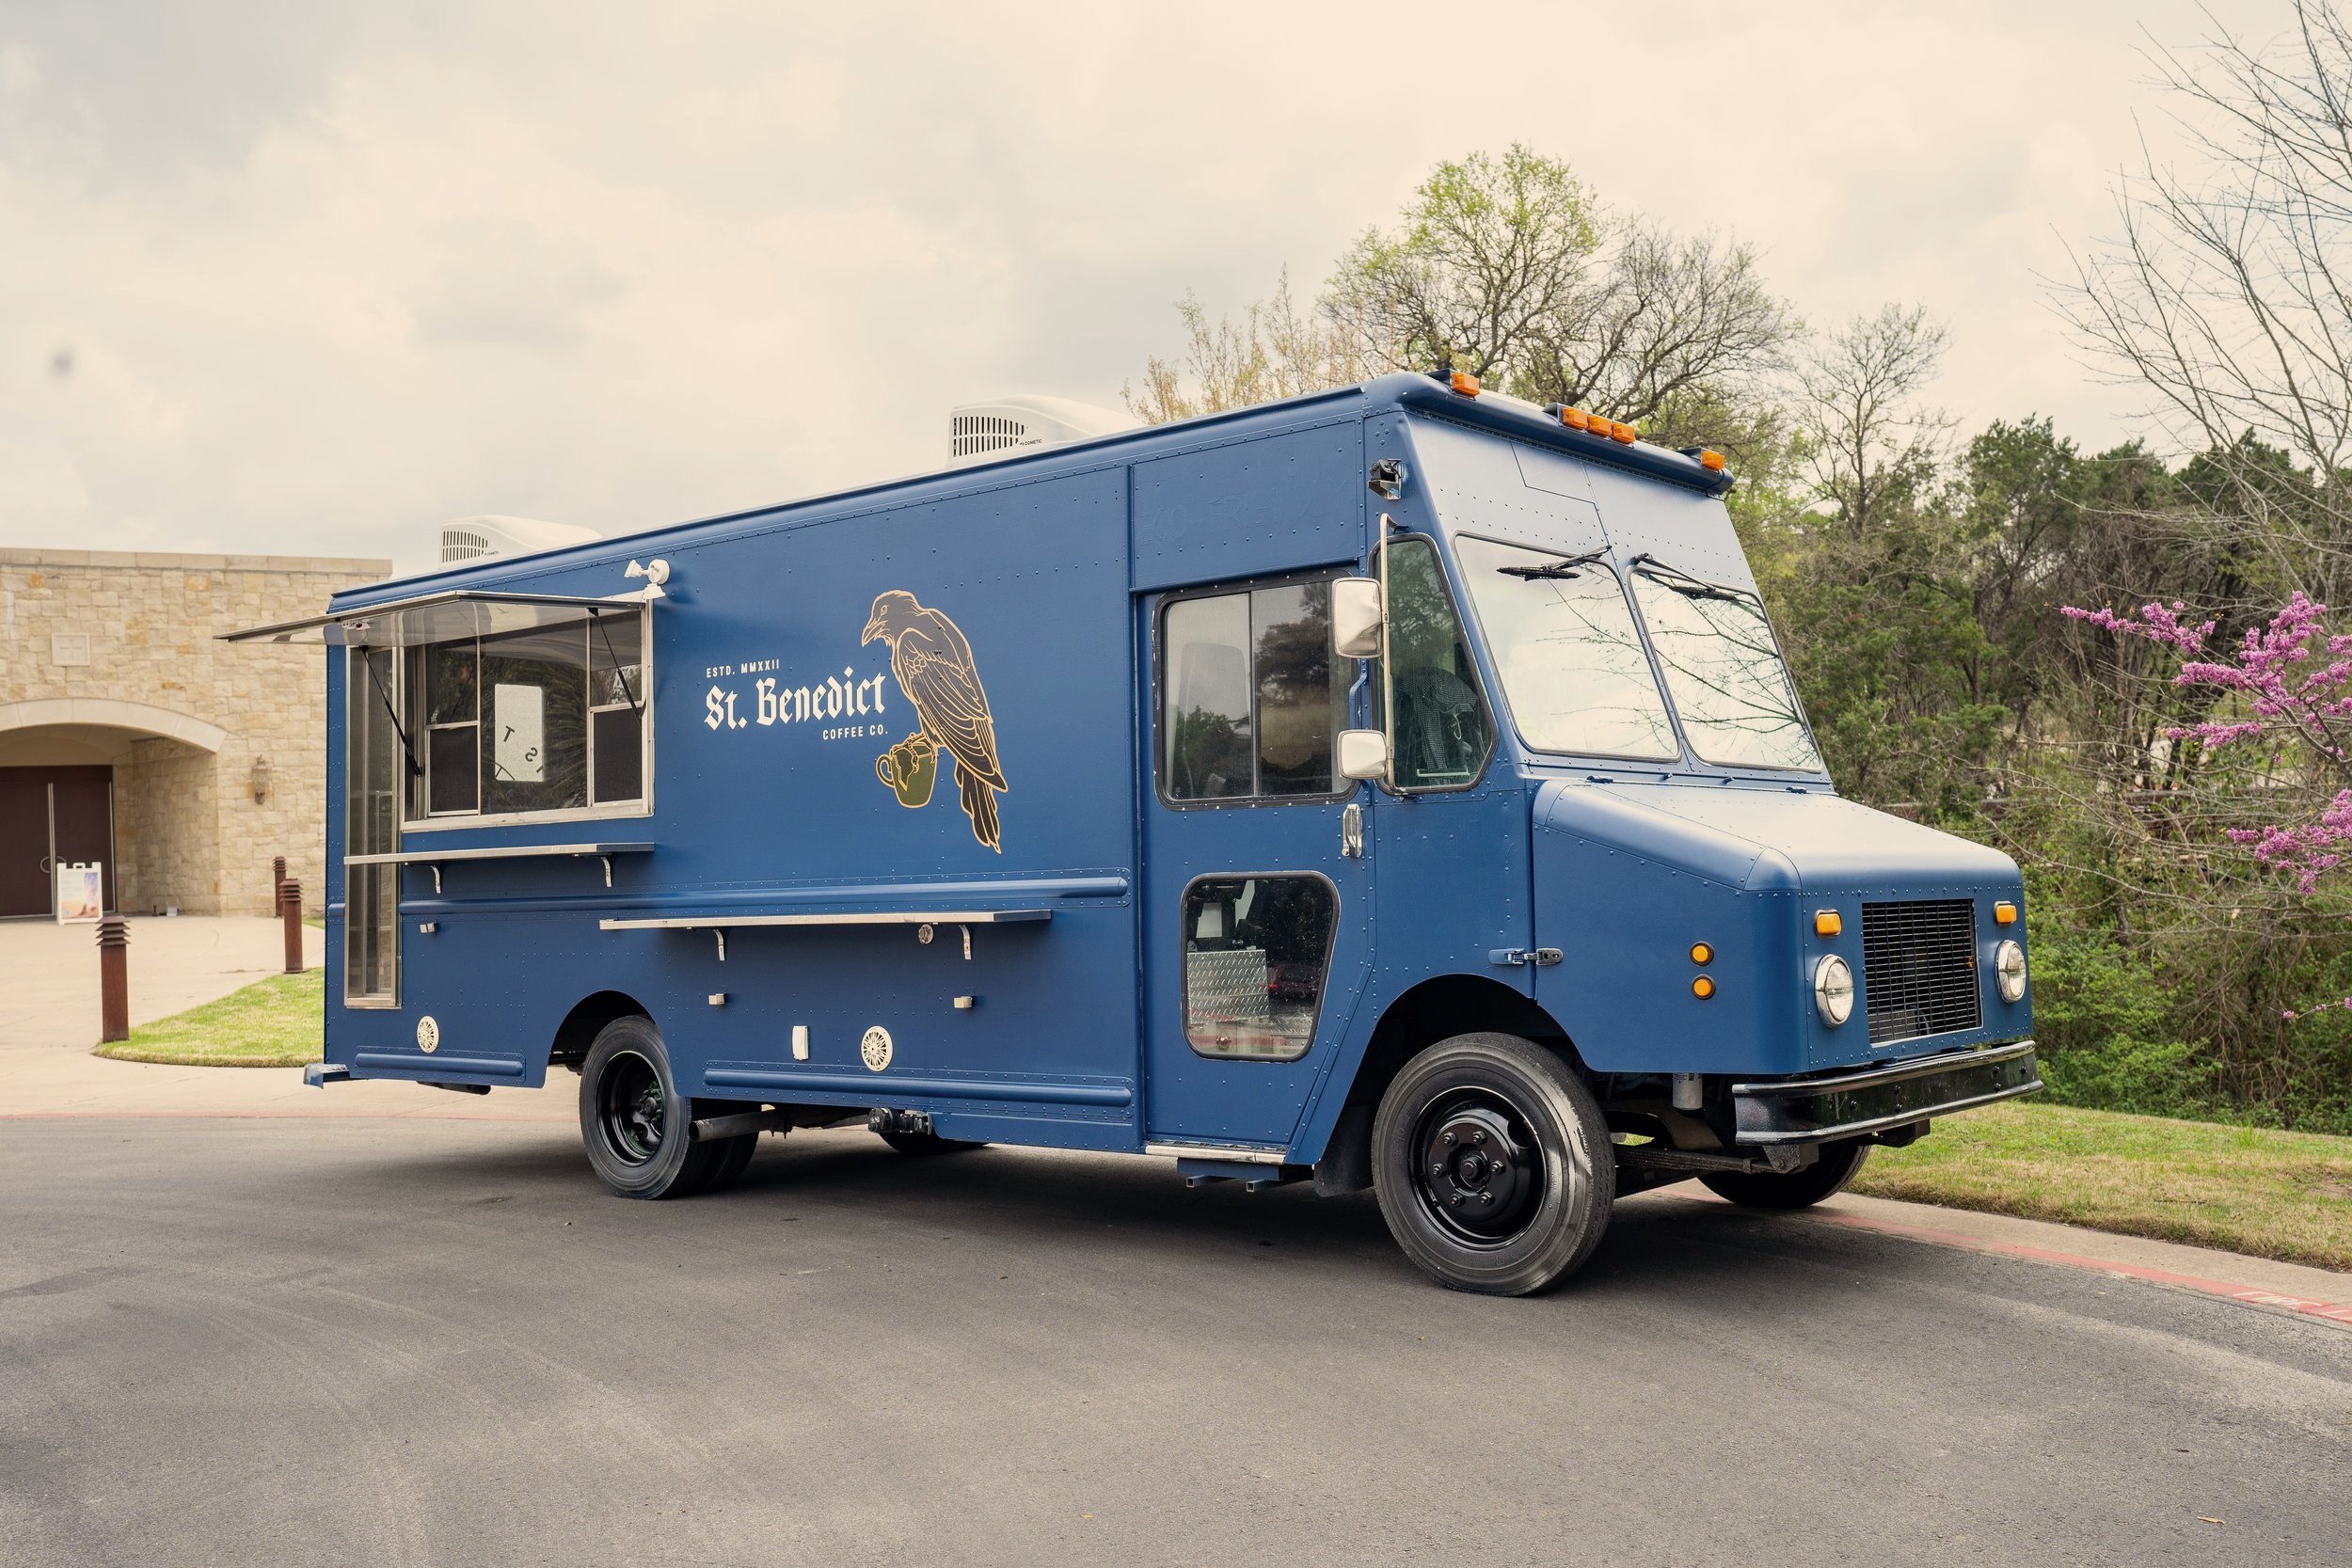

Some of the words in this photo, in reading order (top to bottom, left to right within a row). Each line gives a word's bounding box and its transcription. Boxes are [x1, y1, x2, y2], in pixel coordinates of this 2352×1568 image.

[707, 665, 736, 678] ESTD.
[740, 658, 780, 674] MMXXII
[704, 685, 748, 731] St.
[755, 666, 886, 726] Benedict
[822, 725, 864, 740] COFFEE
[869, 723, 888, 736] CO.
